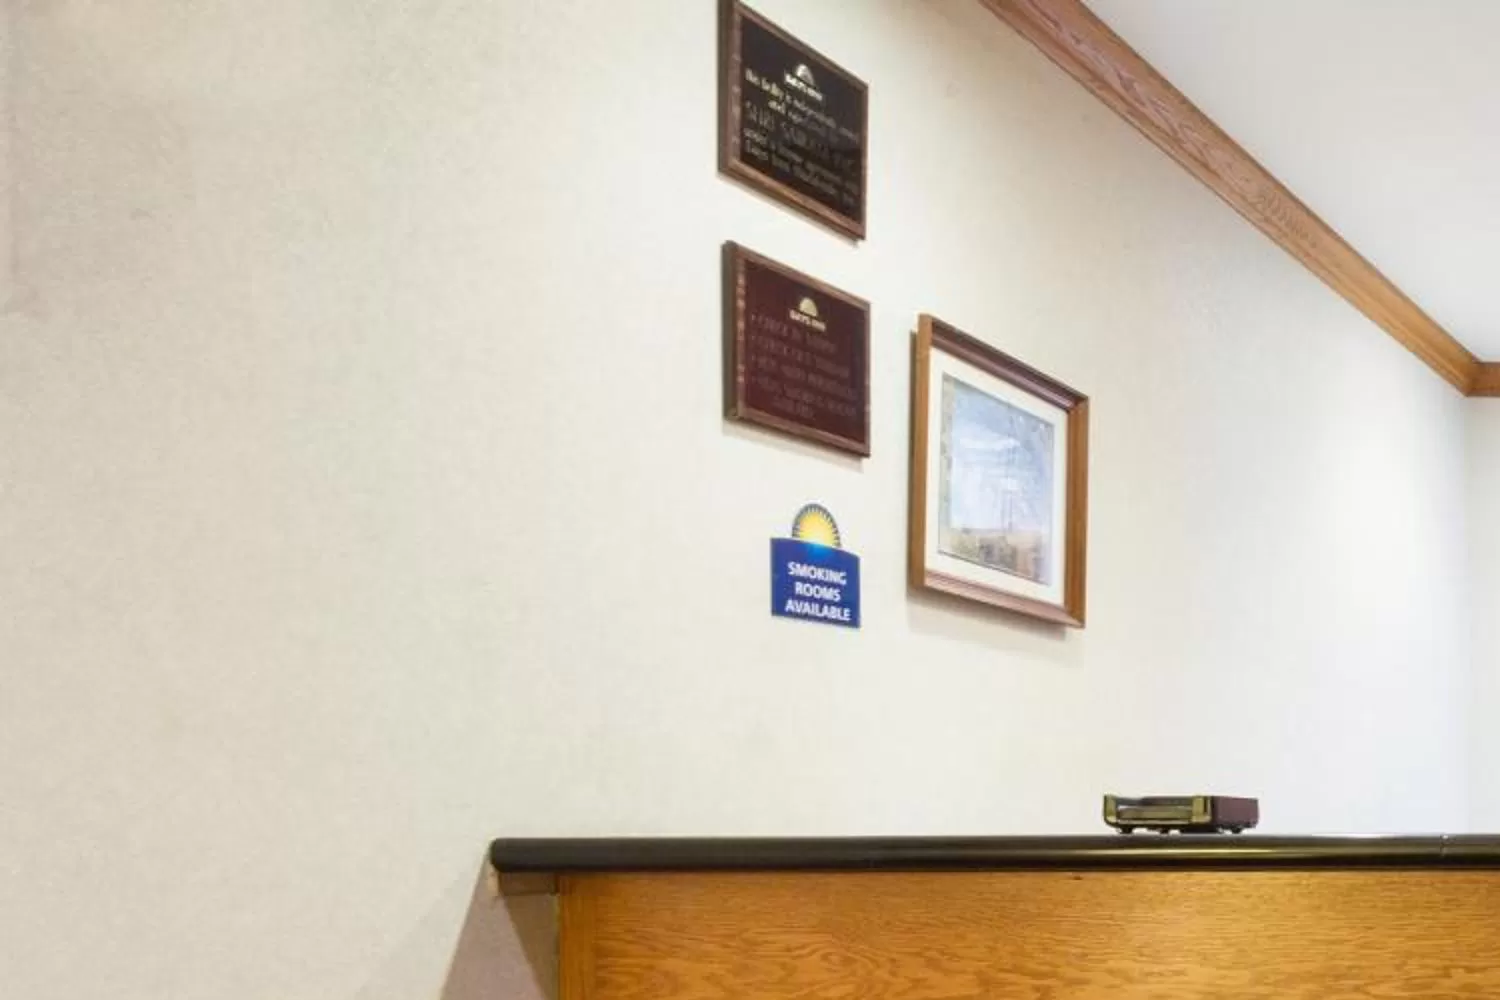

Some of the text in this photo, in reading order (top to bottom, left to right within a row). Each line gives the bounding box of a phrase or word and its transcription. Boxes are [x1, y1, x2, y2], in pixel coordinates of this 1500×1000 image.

[787, 561, 847, 585] SMOKING
[795, 581, 841, 602] ROOMS
[785, 598, 851, 621] AVAILABLE
